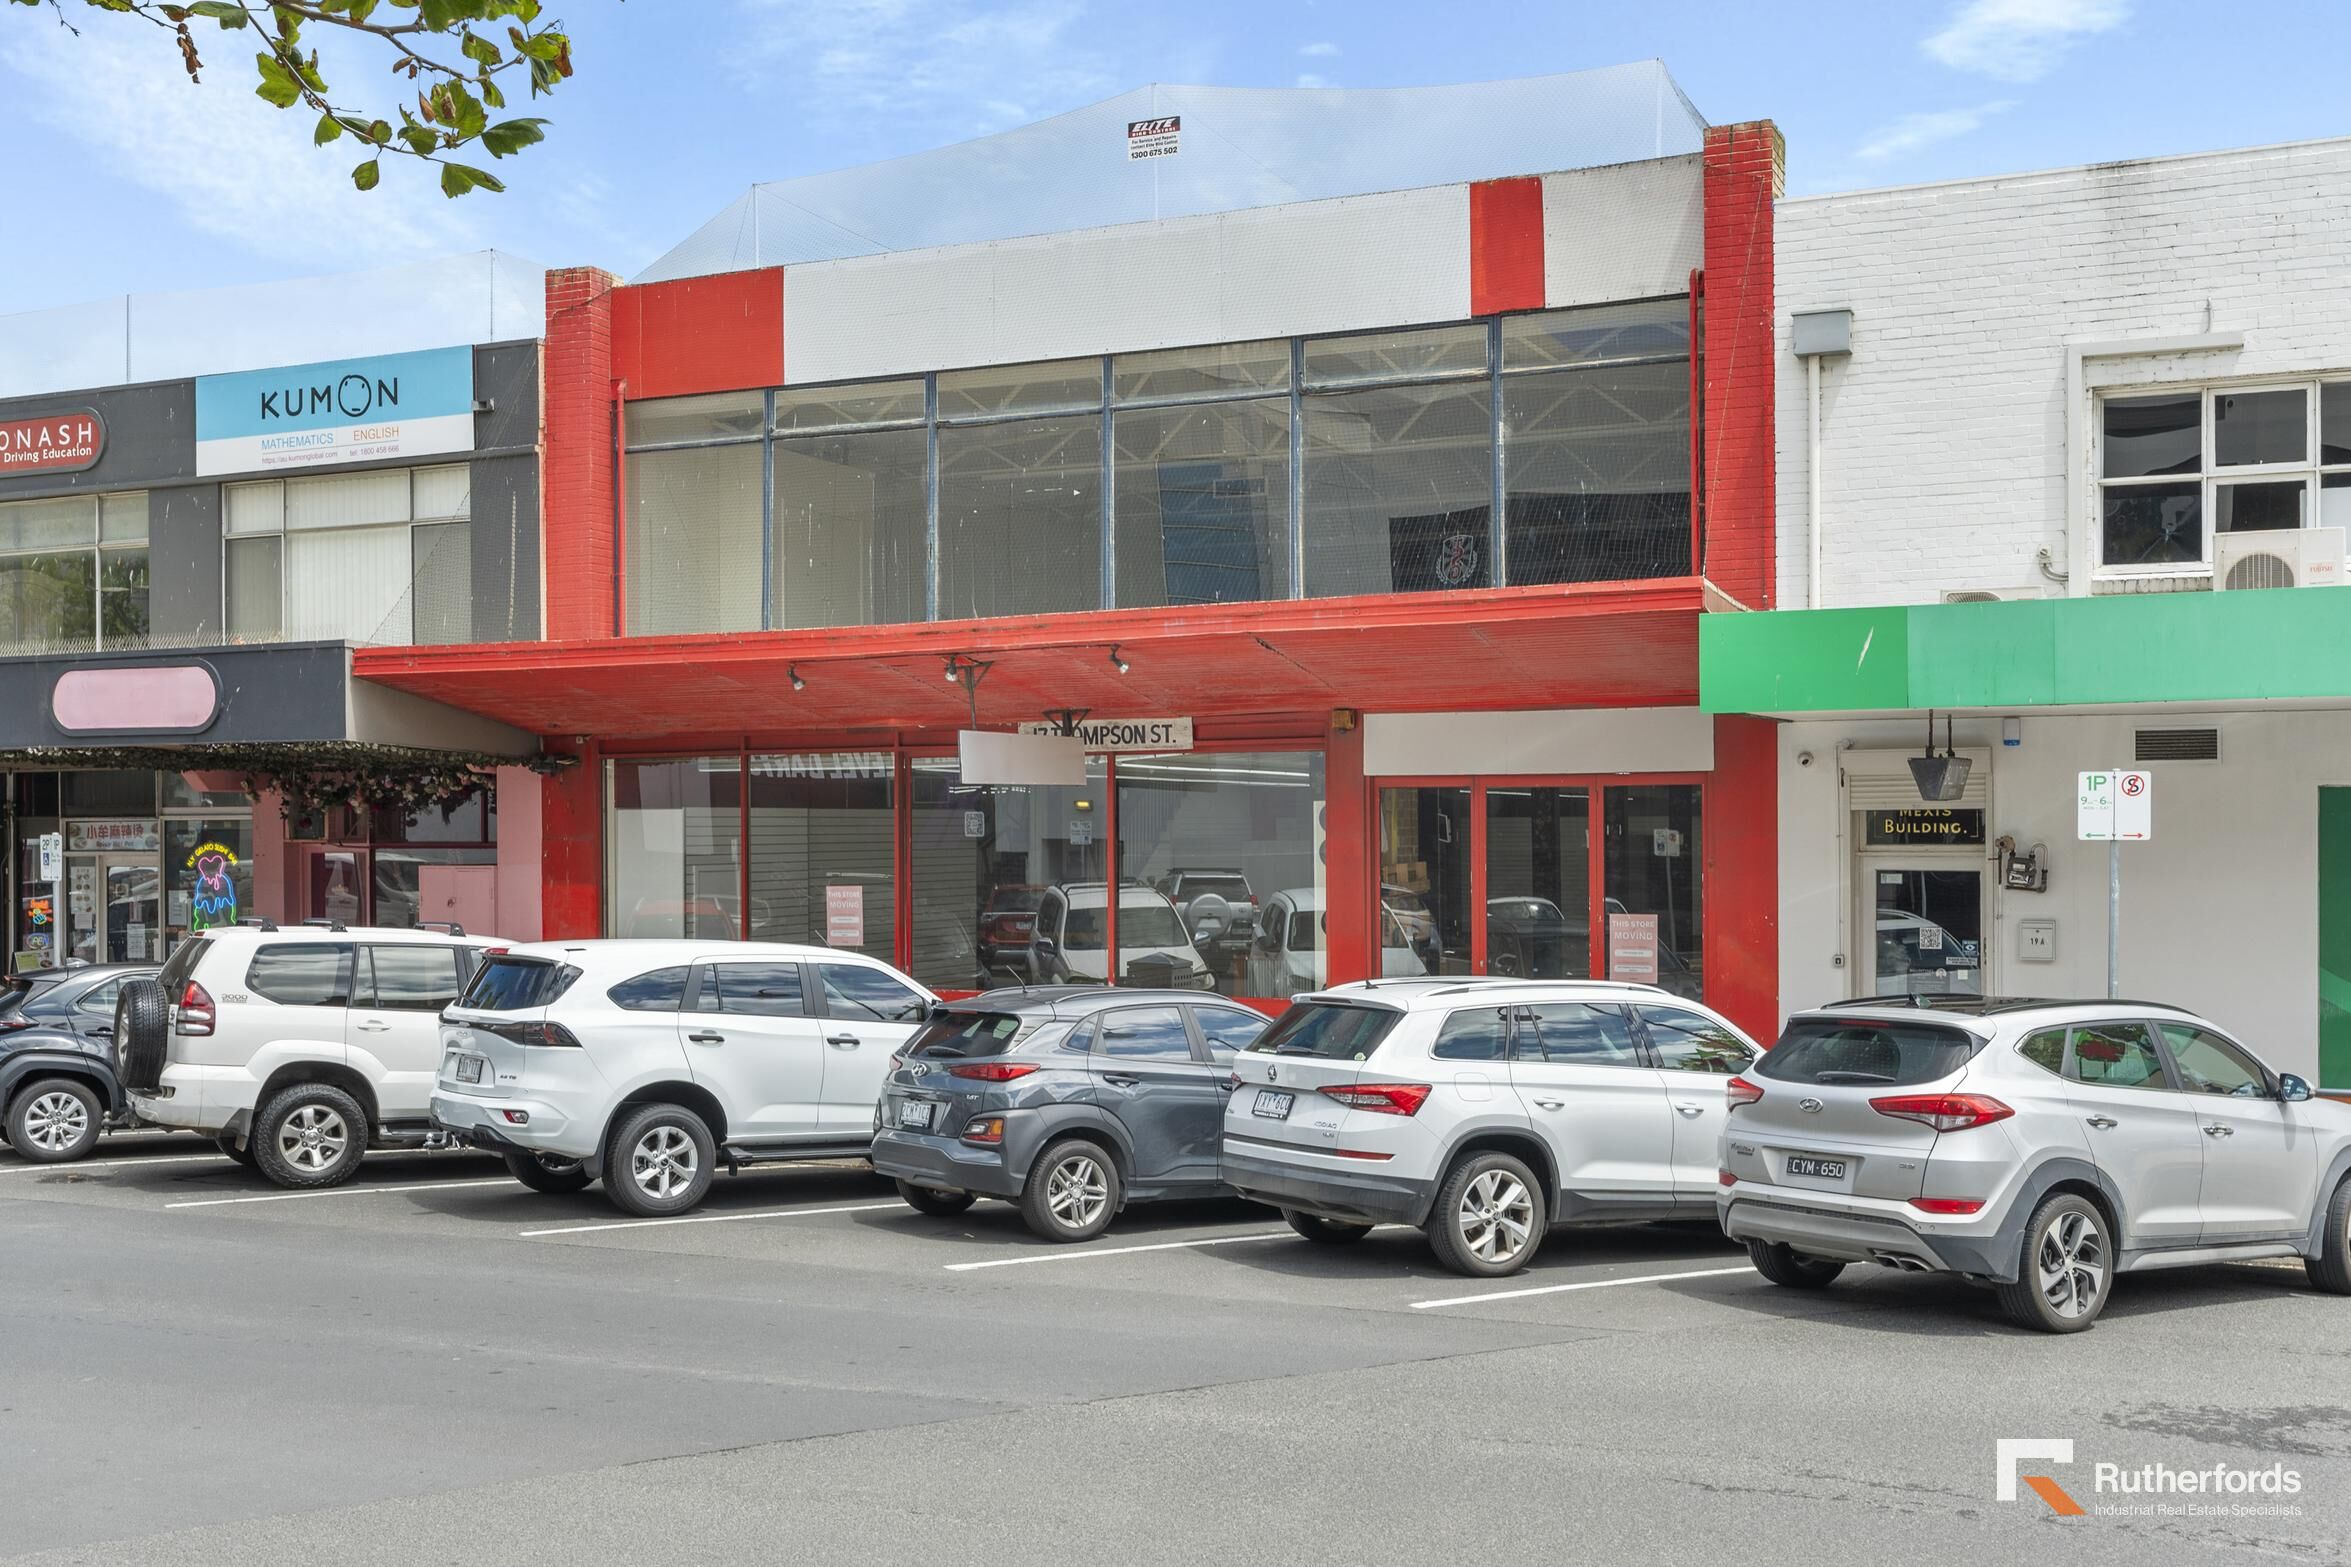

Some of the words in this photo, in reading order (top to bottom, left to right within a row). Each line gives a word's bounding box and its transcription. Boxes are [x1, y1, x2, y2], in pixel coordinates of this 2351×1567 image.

[1132, 118, 1176, 132] ELITE
[1131, 150, 1148, 159] 1300
[1149, 148, 1162, 157] 675
[1164, 146, 1178, 155] 502
[261, 374, 399, 420] KUMON
[261, 432, 334, 450] MATHEMATICS
[353, 426, 400, 441] ENGLISH
[4, 451, 39, 463] Driving
[43, 442, 92, 459] Education
[1150, 724, 1177, 744] ST.
[2086, 775, 2107, 791] 1P
[42, 839, 49, 851] 2P
[830, 901, 860, 909] MOVING
[1612, 920, 1630, 928] THIS
[1631, 920, 1654, 928] STORE
[1615, 931, 1653, 940] MOVING
